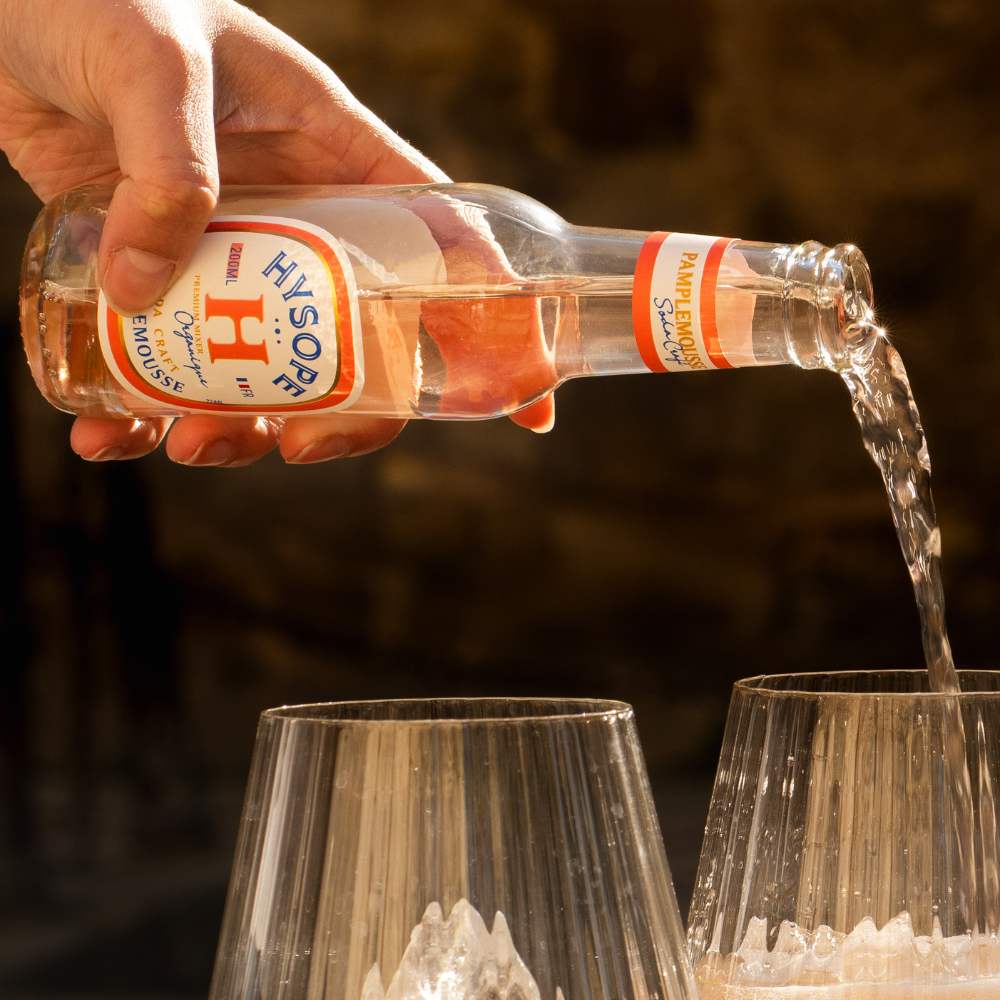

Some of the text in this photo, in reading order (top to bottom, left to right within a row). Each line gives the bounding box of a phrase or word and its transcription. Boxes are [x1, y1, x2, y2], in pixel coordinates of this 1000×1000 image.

[225, 247, 242, 286] 200ML
[153, 298, 180, 373] DA CRAFT
[173, 310, 208, 388] Organique
[193, 275, 203, 354] PREMIUM MIXER
[205, 292, 270, 366] H
[261, 250, 321, 397] HYSOPE
[675, 252, 707, 369] PAMPLEMOUSSE
[132, 314, 185, 393] EMOUSSE
[240, 389, 254, 398] FR
